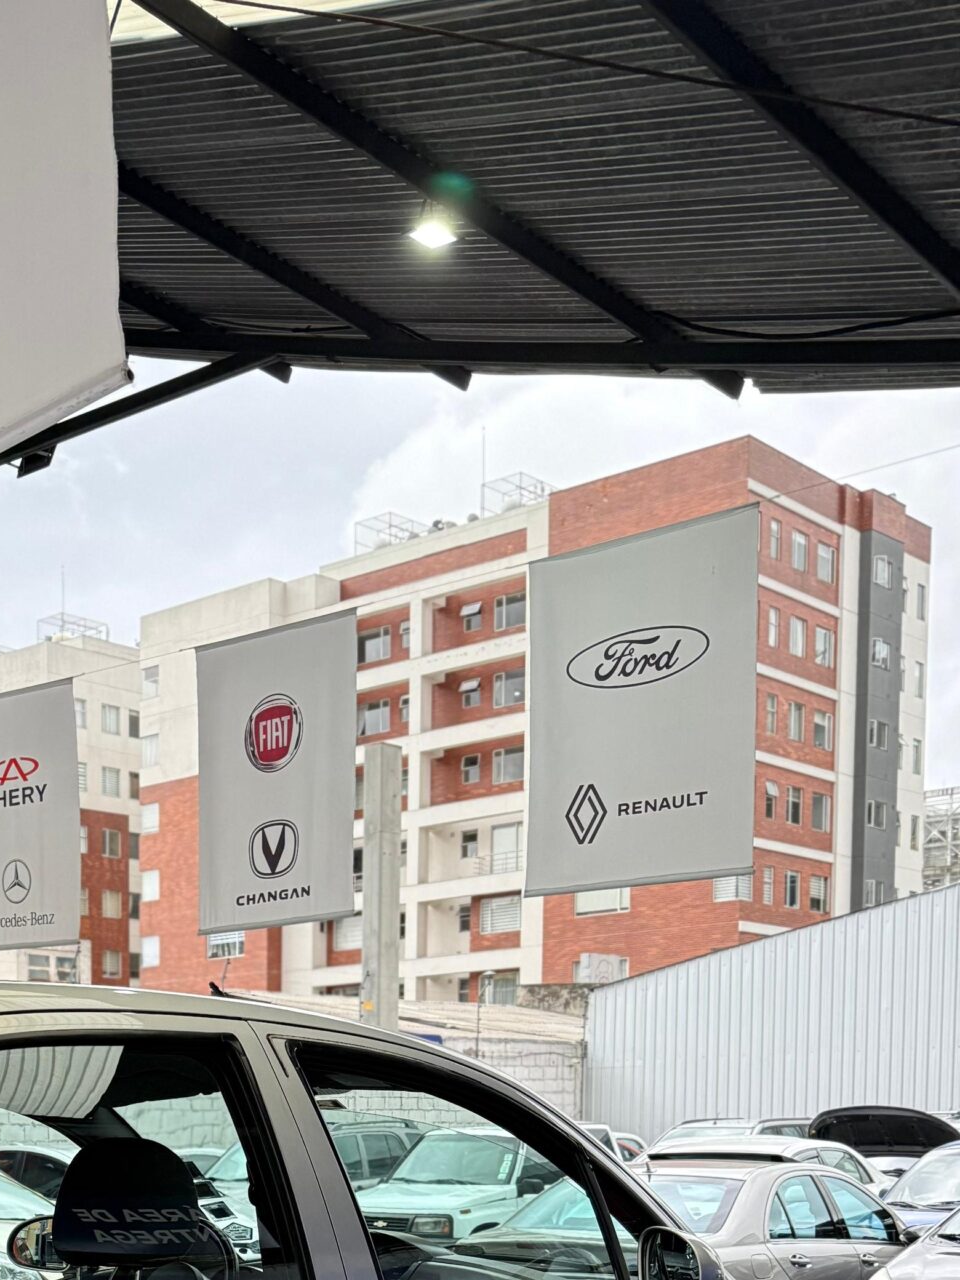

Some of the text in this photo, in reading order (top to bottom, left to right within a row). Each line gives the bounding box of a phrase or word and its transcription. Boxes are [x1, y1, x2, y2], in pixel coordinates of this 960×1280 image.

[595, 635, 683, 682] Ford
[259, 716, 292, 753] FIAT
[617, 790, 709, 818] RENAULT
[235, 884, 311, 907] CHANGAN
